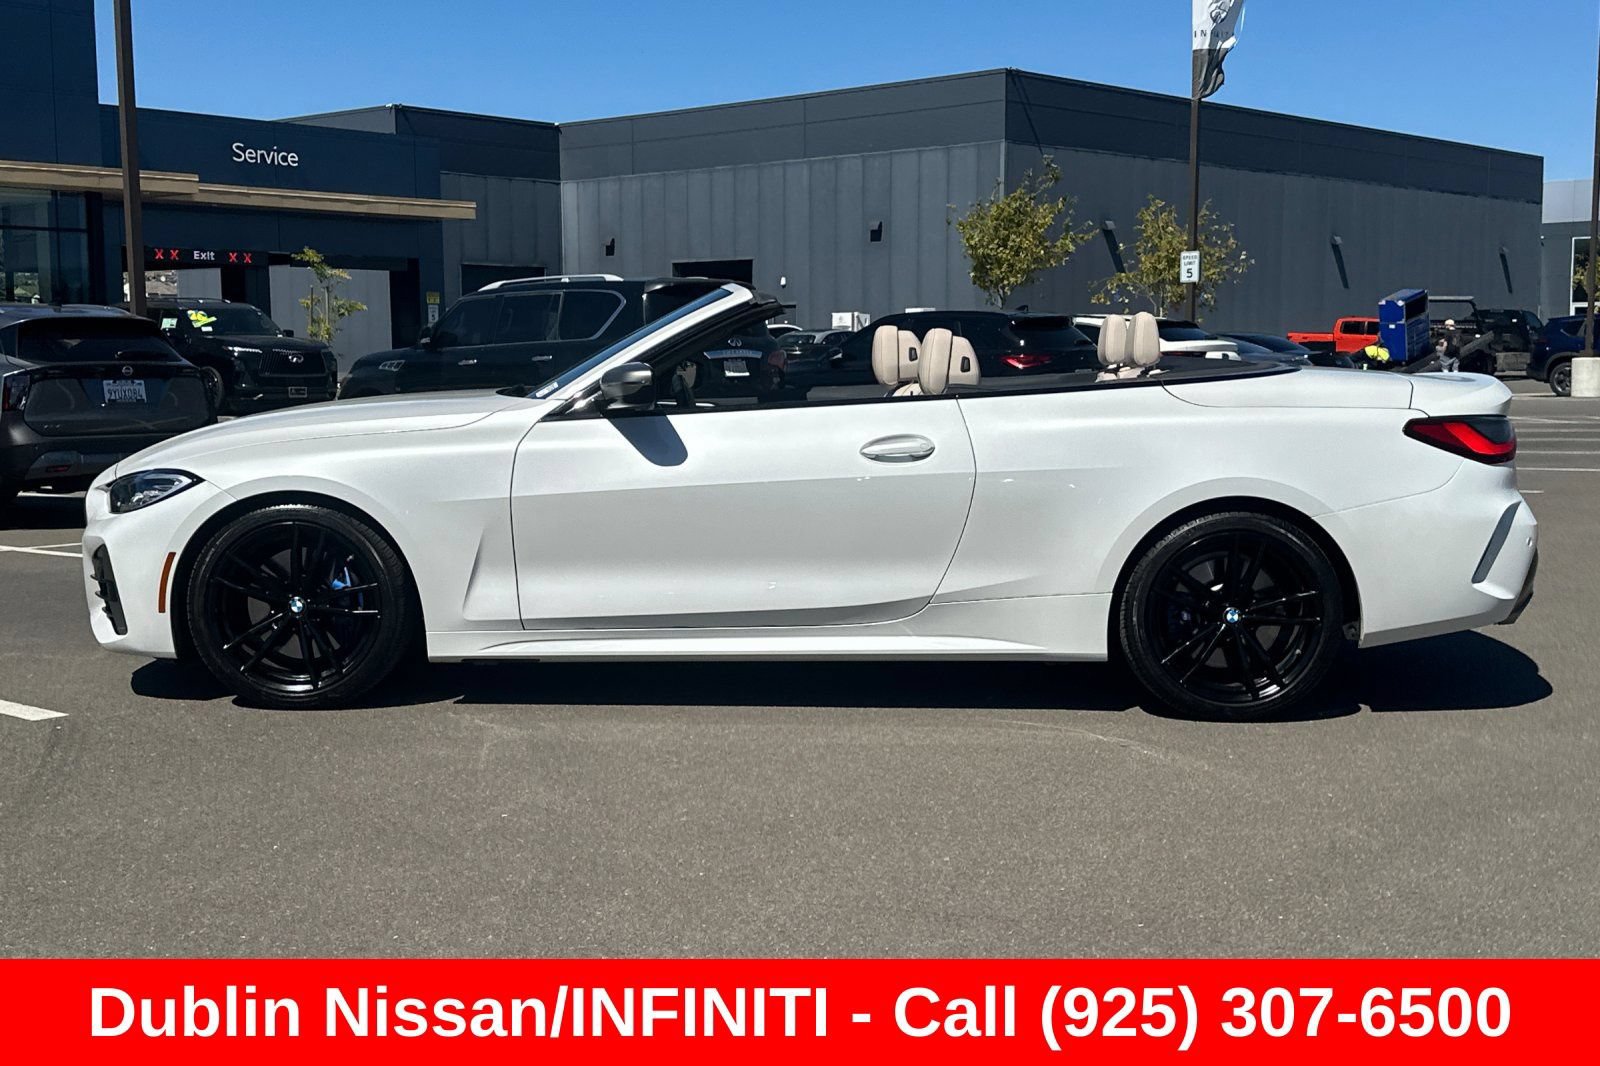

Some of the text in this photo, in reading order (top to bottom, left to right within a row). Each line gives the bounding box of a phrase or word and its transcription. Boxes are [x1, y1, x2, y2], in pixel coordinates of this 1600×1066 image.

[232, 142, 299, 167] Service
[193, 250, 216, 261] Exit
[1186, 268, 1193, 279] 5
